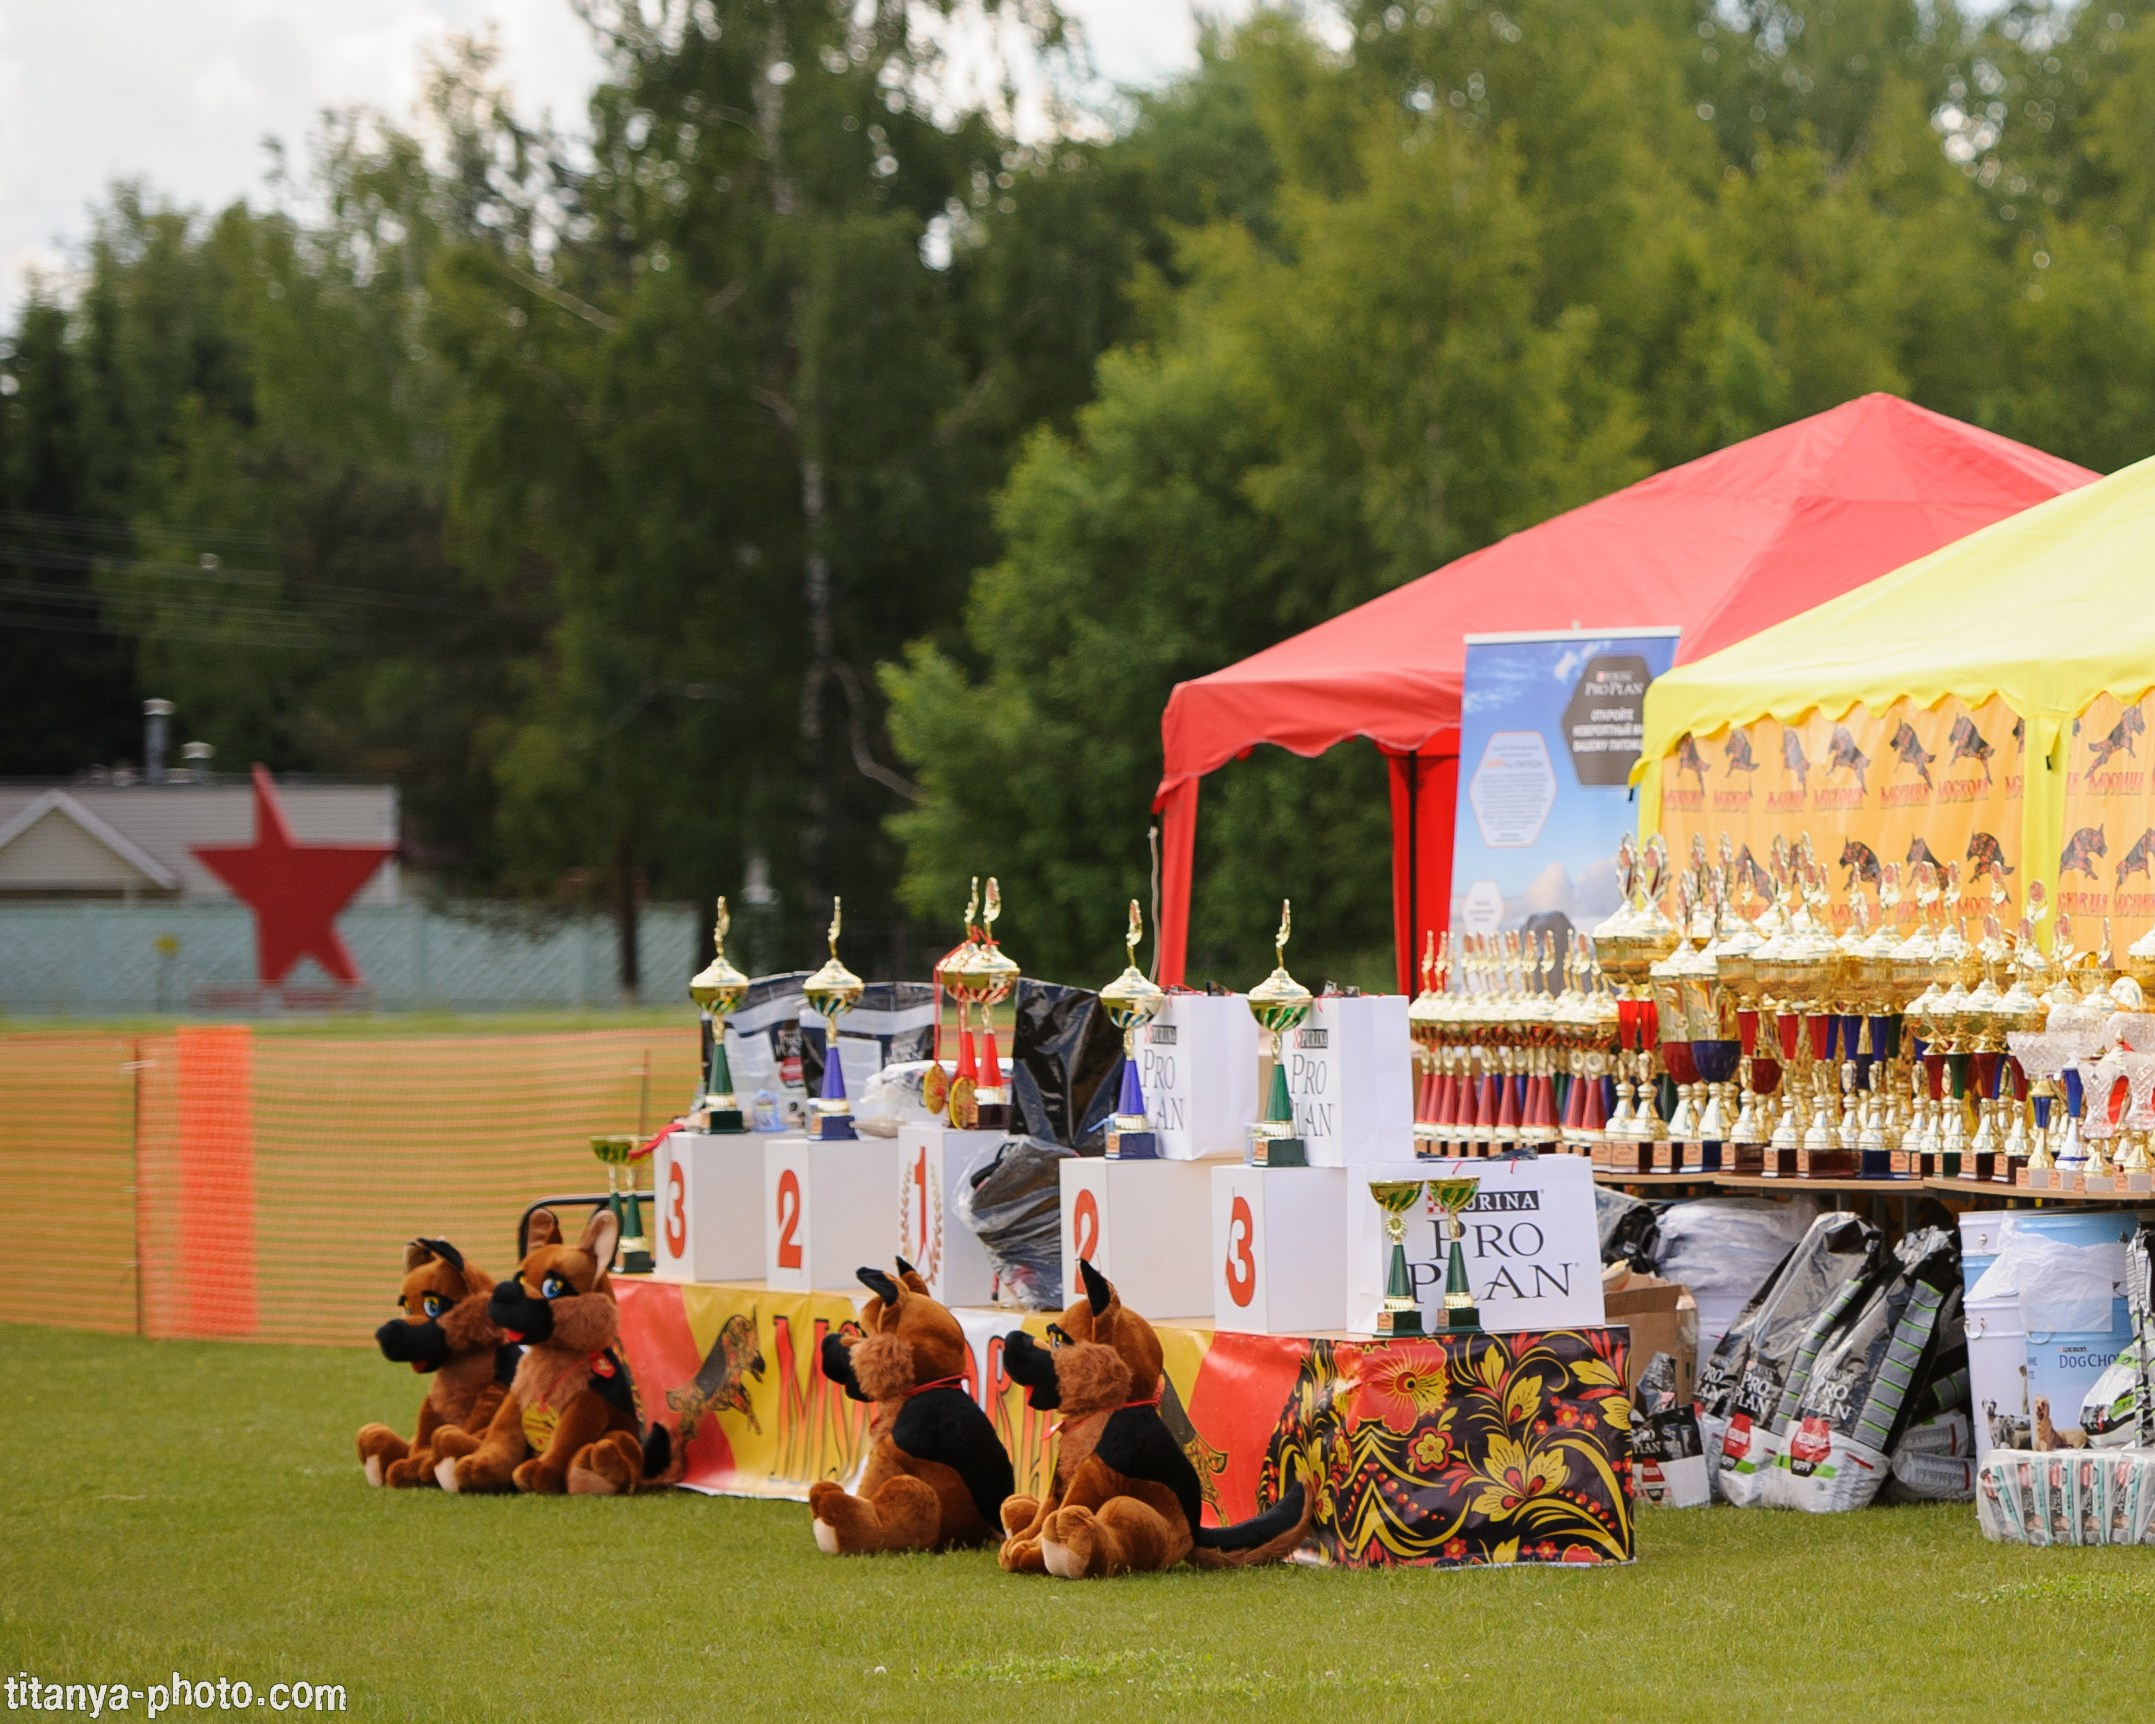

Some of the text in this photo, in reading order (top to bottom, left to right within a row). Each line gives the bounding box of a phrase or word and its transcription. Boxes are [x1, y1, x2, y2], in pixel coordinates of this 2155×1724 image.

[1142, 1049, 1176, 1090] PRO
[1291, 1054, 1327, 1095] PRO
[1145, 1096, 1184, 1130] LAN
[1290, 1097, 1333, 1137] LAN
[665, 1161, 686, 1260] 3
[776, 1169, 803, 1268] 2
[1462, 1191, 1539, 1212] URINA
[1225, 1195, 1256, 1308] 3
[1426, 1220, 1545, 1261] PRO
[1405, 1261, 1573, 1305] PAN
[1733, 1385, 1771, 1415] PLAN
[1741, 1370, 1771, 1396] PRO
